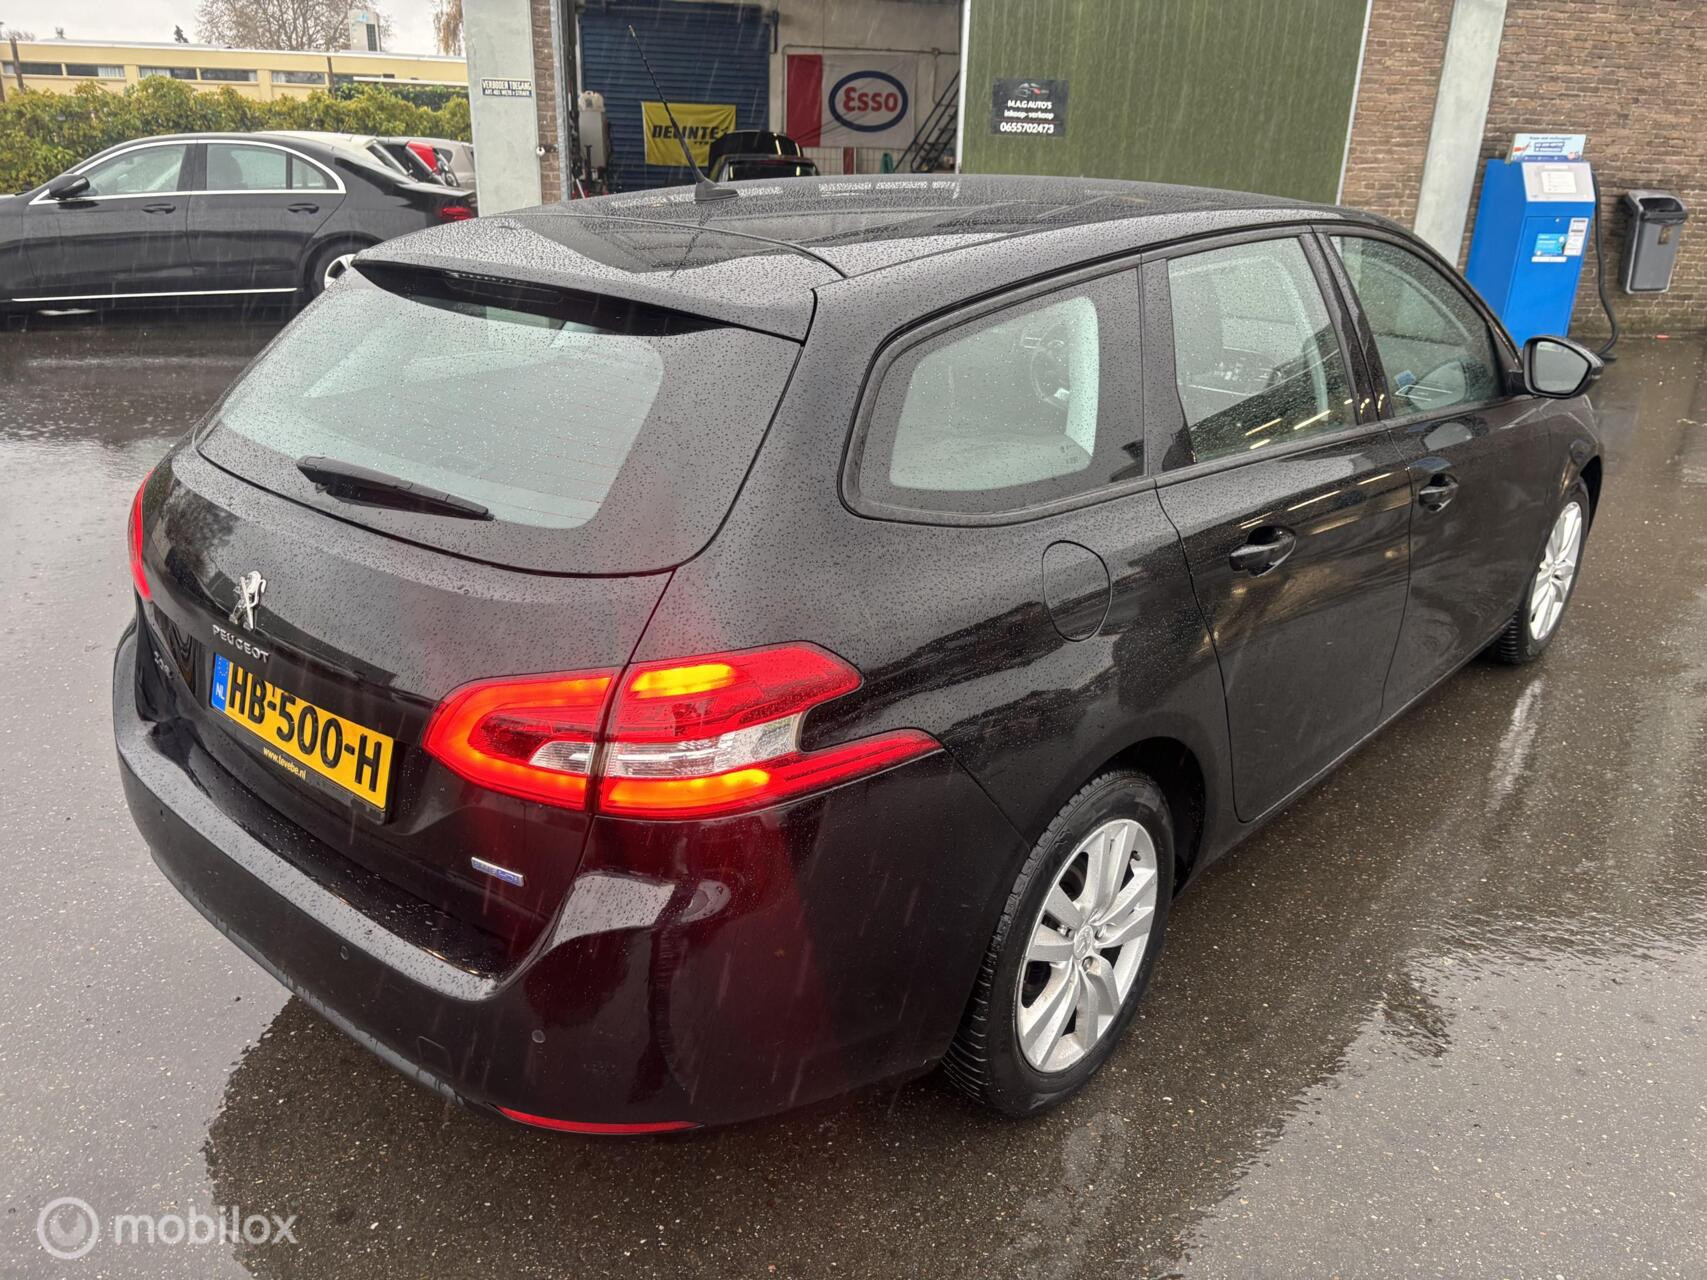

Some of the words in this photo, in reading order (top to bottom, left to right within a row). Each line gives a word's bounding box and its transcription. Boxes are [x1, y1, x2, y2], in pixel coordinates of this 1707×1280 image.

[1000, 122, 1054, 133] 0655702473
[212, 624, 269, 663] PEUGEOT
[215, 682, 225, 700] NL
[228, 662, 382, 793] HB-500-H
